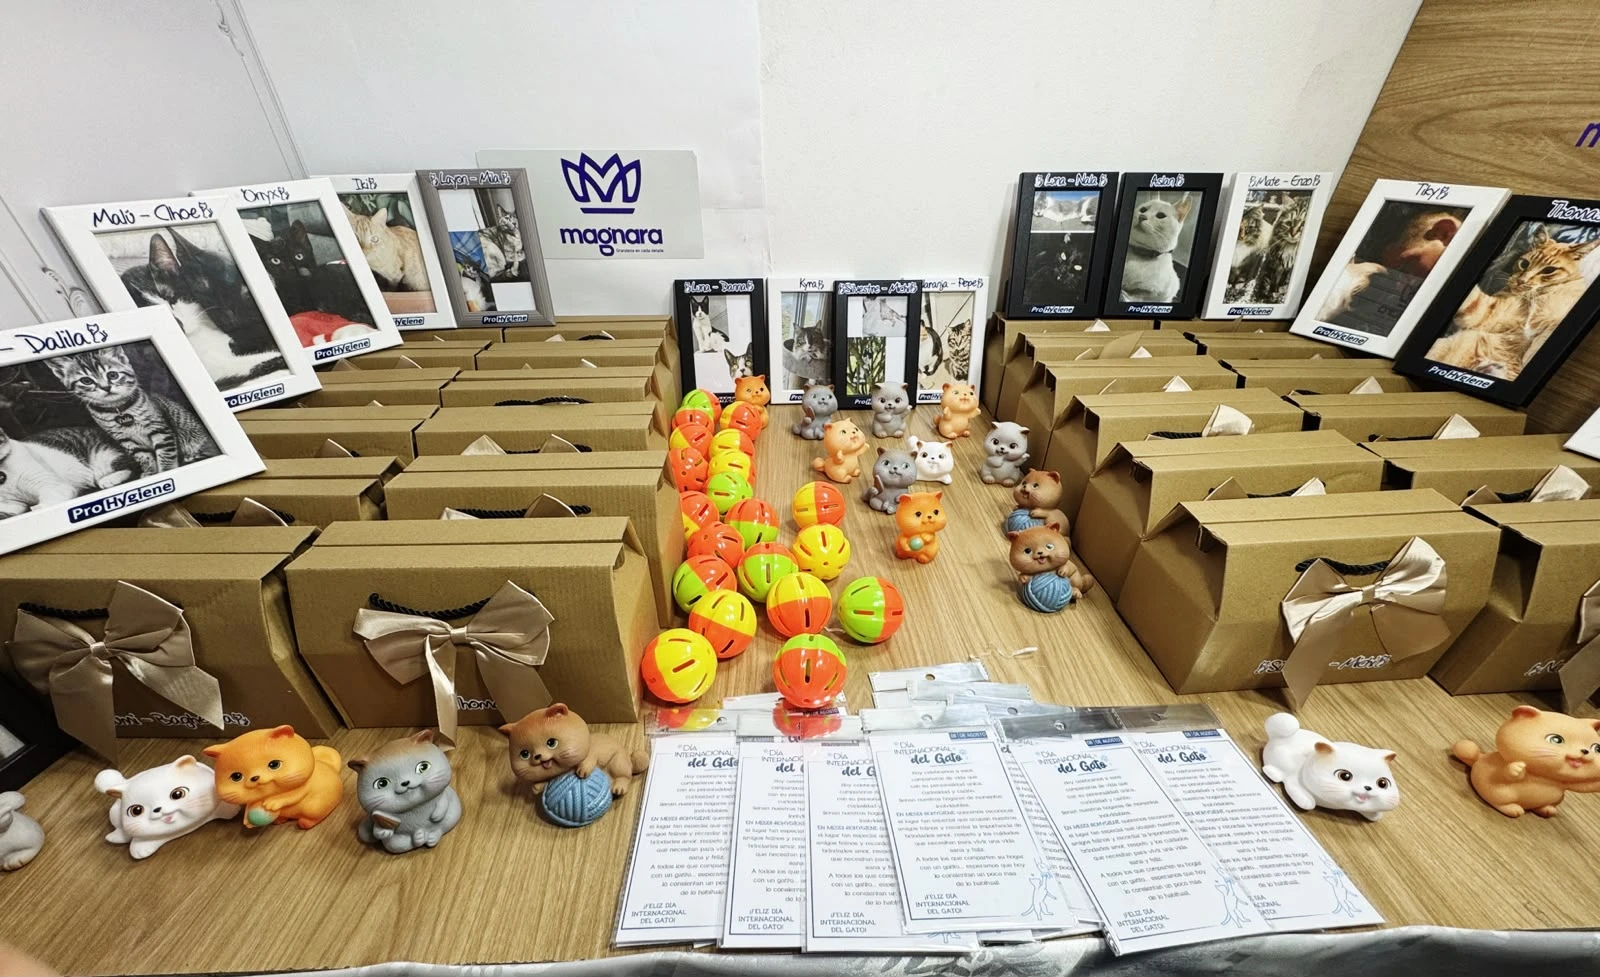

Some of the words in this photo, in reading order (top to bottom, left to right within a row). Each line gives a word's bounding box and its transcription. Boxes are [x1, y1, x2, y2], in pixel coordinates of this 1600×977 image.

[240, 188, 279, 204] Onyx
[1548, 200, 1600, 222] Thoma
[560, 227, 663, 256] magnara
[484, 315, 527, 324] ProHygiene
[14, 330, 91, 353] Dalila
[1315, 327, 1365, 344] ProHygiene
[316, 340, 369, 358] ProHygiene
[1428, 366, 1490, 388] ProHygiene
[72, 482, 172, 520] ProHygiene
[688, 757, 706, 768] del
[911, 754, 930, 764] del
[935, 753, 962, 764] Gato
[1158, 752, 1176, 763] del
[1179, 751, 1206, 762] Gato
[776, 763, 795, 772] del
[842, 766, 861, 776] del
[1058, 762, 1076, 774] del
[1080, 759, 1107, 772] Gato
[1117, 914, 1169, 927] INTERNACIONAL
